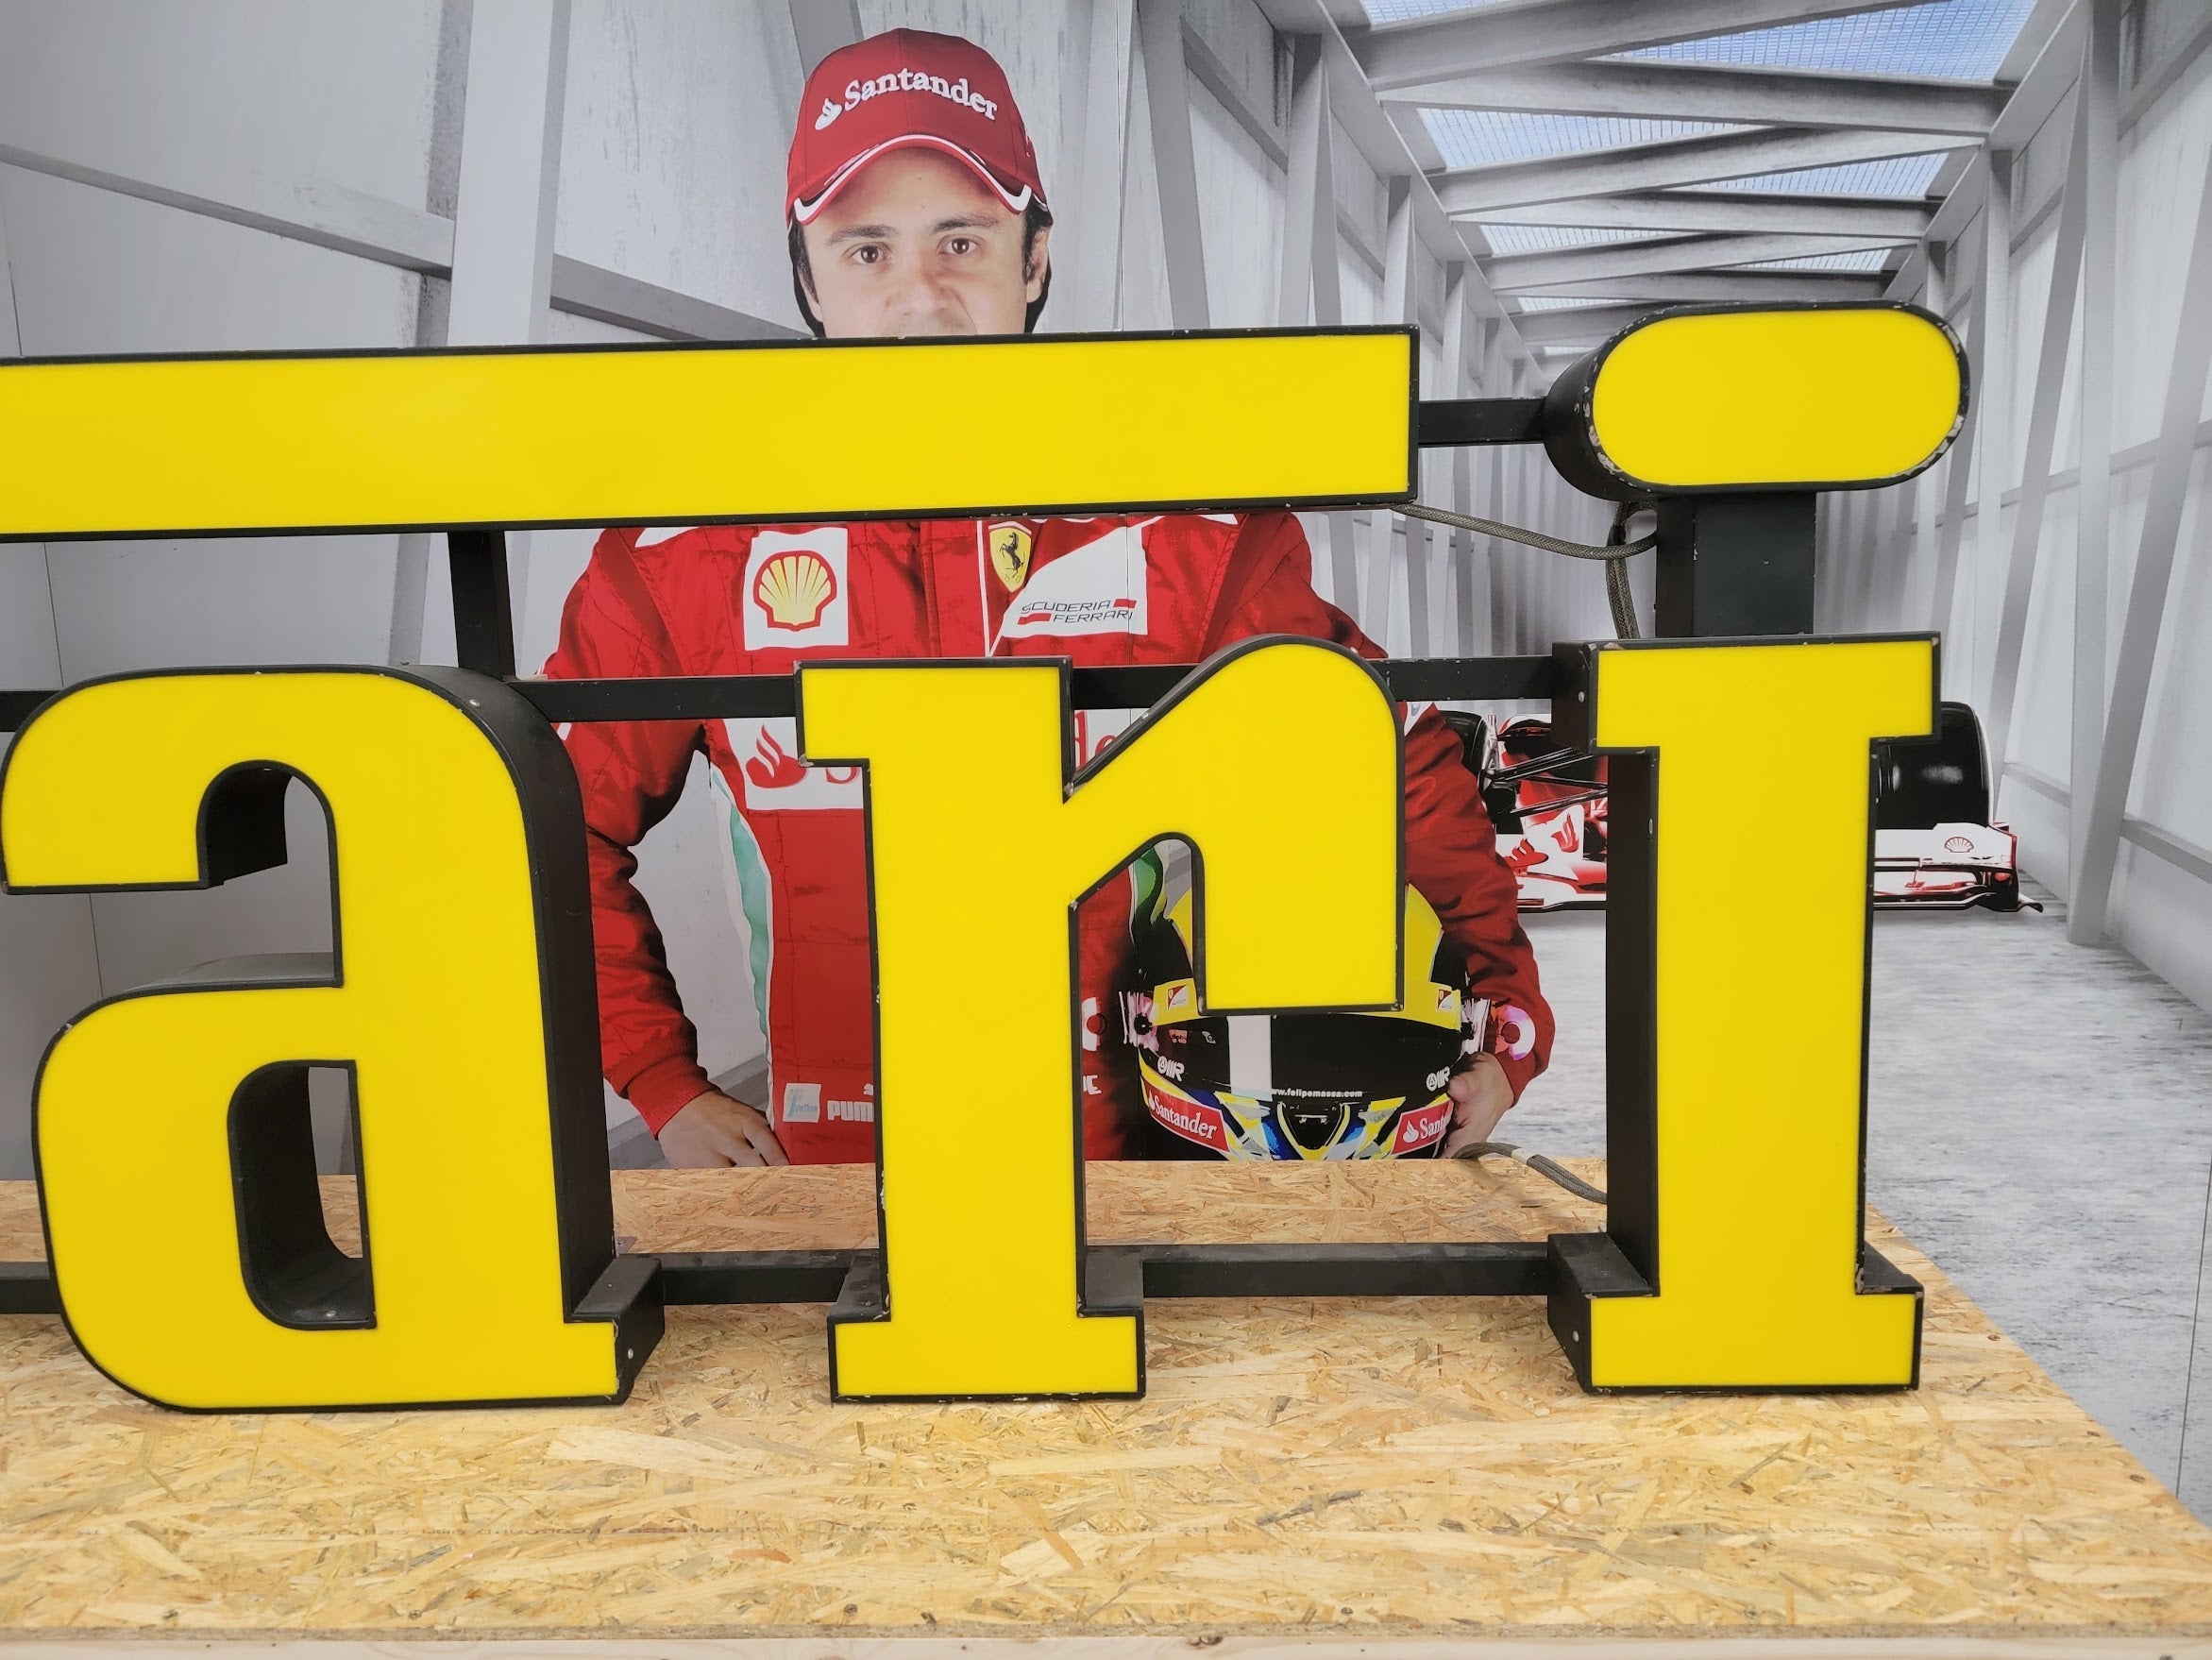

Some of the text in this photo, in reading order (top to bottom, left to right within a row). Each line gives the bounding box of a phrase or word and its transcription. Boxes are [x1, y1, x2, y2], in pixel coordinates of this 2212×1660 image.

[844, 68, 998, 120] Santander
[1022, 600, 1111, 615] SCUDERIA
[1053, 609, 1133, 624] FERRARI
[827, 1100, 874, 1123] PUM
[1155, 1095, 1218, 1140] Santander
